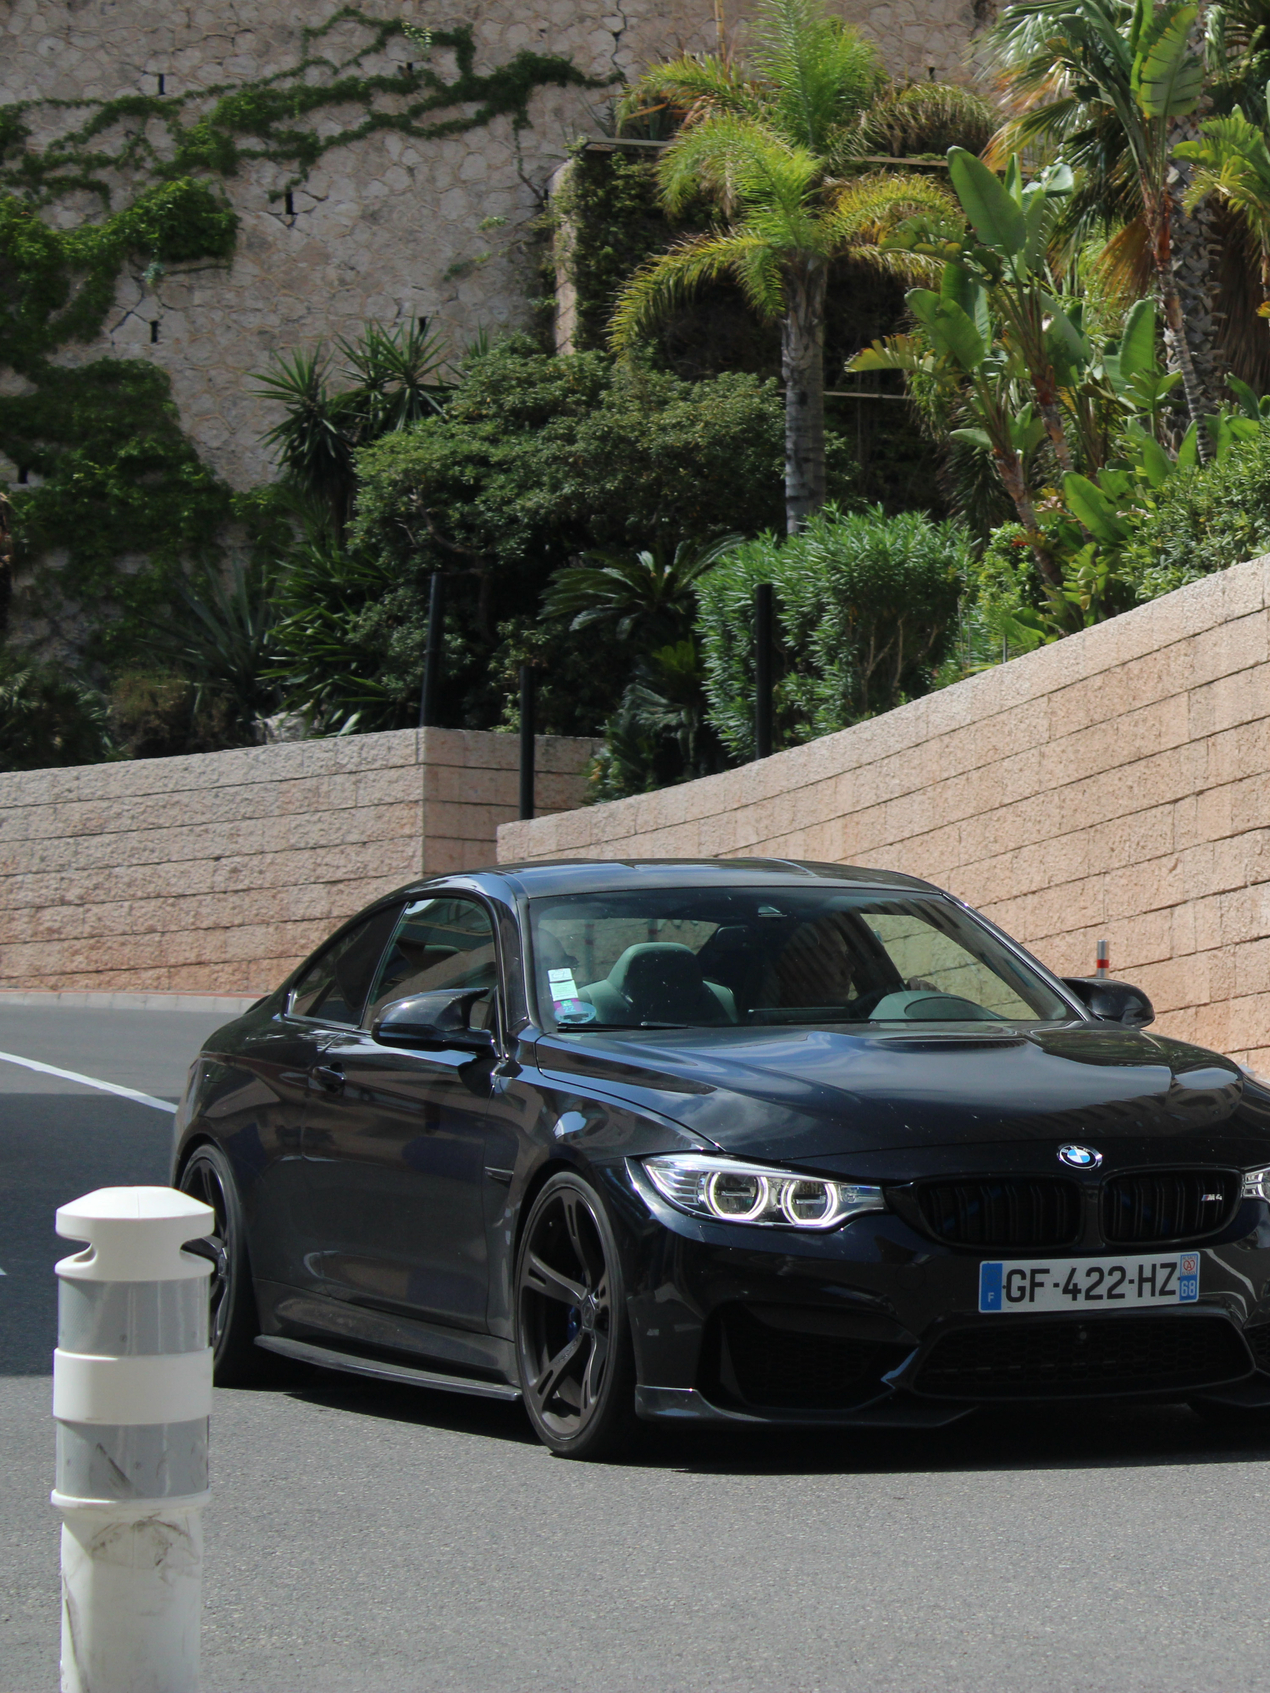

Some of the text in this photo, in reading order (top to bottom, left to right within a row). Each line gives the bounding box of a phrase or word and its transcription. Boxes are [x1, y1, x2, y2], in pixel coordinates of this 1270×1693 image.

[987, 1262, 1196, 1303] F GF-422-HZ 68
